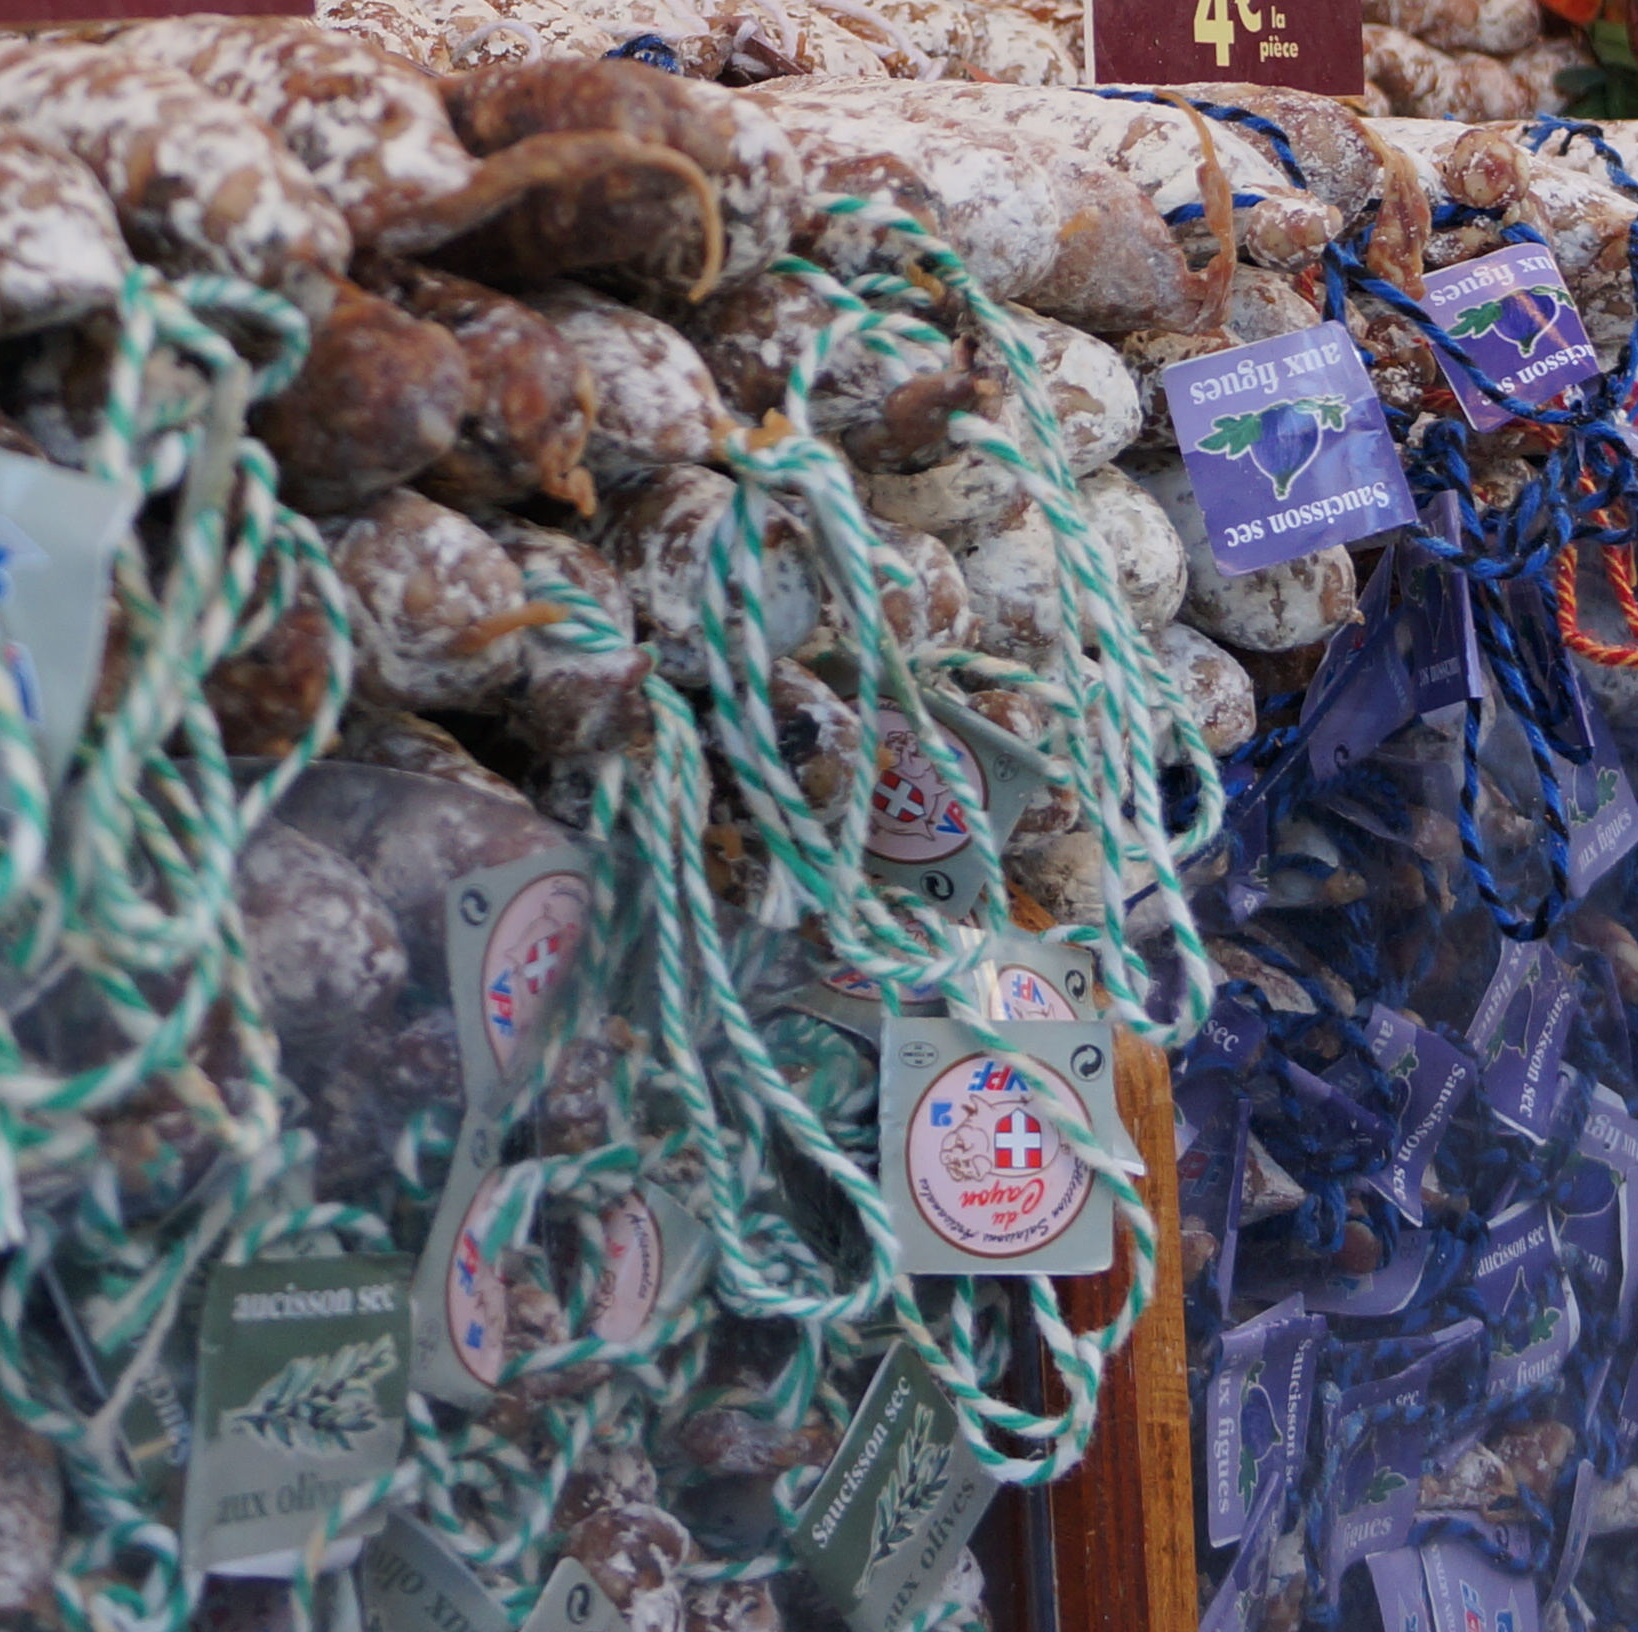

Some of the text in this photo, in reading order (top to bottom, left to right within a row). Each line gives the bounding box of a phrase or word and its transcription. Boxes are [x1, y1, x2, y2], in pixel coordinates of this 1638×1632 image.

[1259, 35, 1300, 63] pièce
[1269, 4, 1286, 30] la
[1429, 261, 1515, 308] figues
[1189, 340, 1342, 406] aux figues
[1223, 480, 1391, 549] Saucisson sec
[1594, 806, 1634, 854] figues
[1395, 1062, 1467, 1164] Saucisson
[917, 1176, 980, 1241] Artisanales
[958, 1176, 1046, 1215] Cayon
[990, 1210, 1021, 1231] du
[1476, 1222, 1546, 1277] aucisson sec
[1285, 1337, 1315, 1460] Saucisson
[811, 1375, 913, 1549] Saucisson sec
[1212, 1415, 1235, 1516] figues
[919, 1479, 977, 1572] olives
